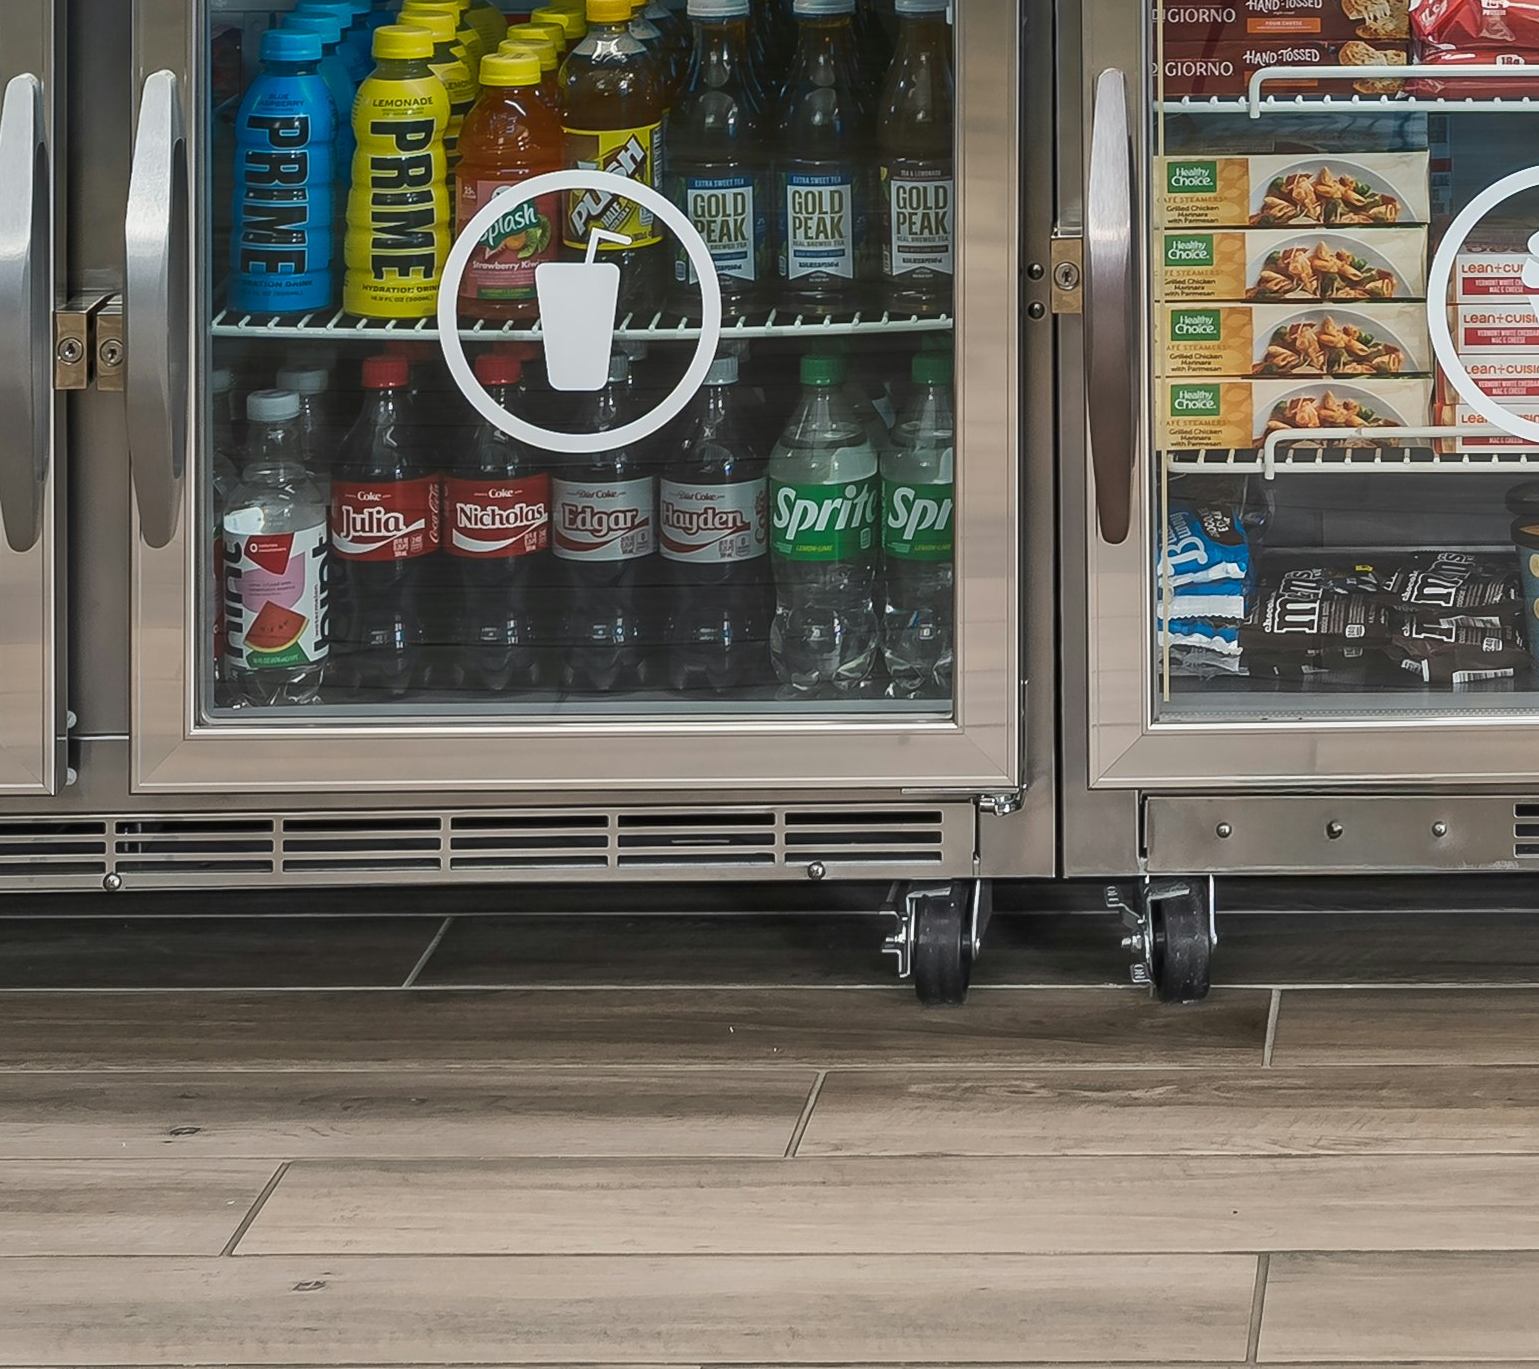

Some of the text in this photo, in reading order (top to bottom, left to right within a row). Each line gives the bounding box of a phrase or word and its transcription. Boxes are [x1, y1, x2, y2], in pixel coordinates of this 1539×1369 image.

[373, 96, 434, 108] LEMONADE
[239, 113, 310, 276] PRIME
[791, 191, 842, 218] GOLD
[791, 214, 844, 241] PEAK
[358, 490, 381, 501] Coke
[341, 503, 404, 537] Julia
[457, 501, 545, 529] Nicholas
[563, 505, 638, 536] Edgar
